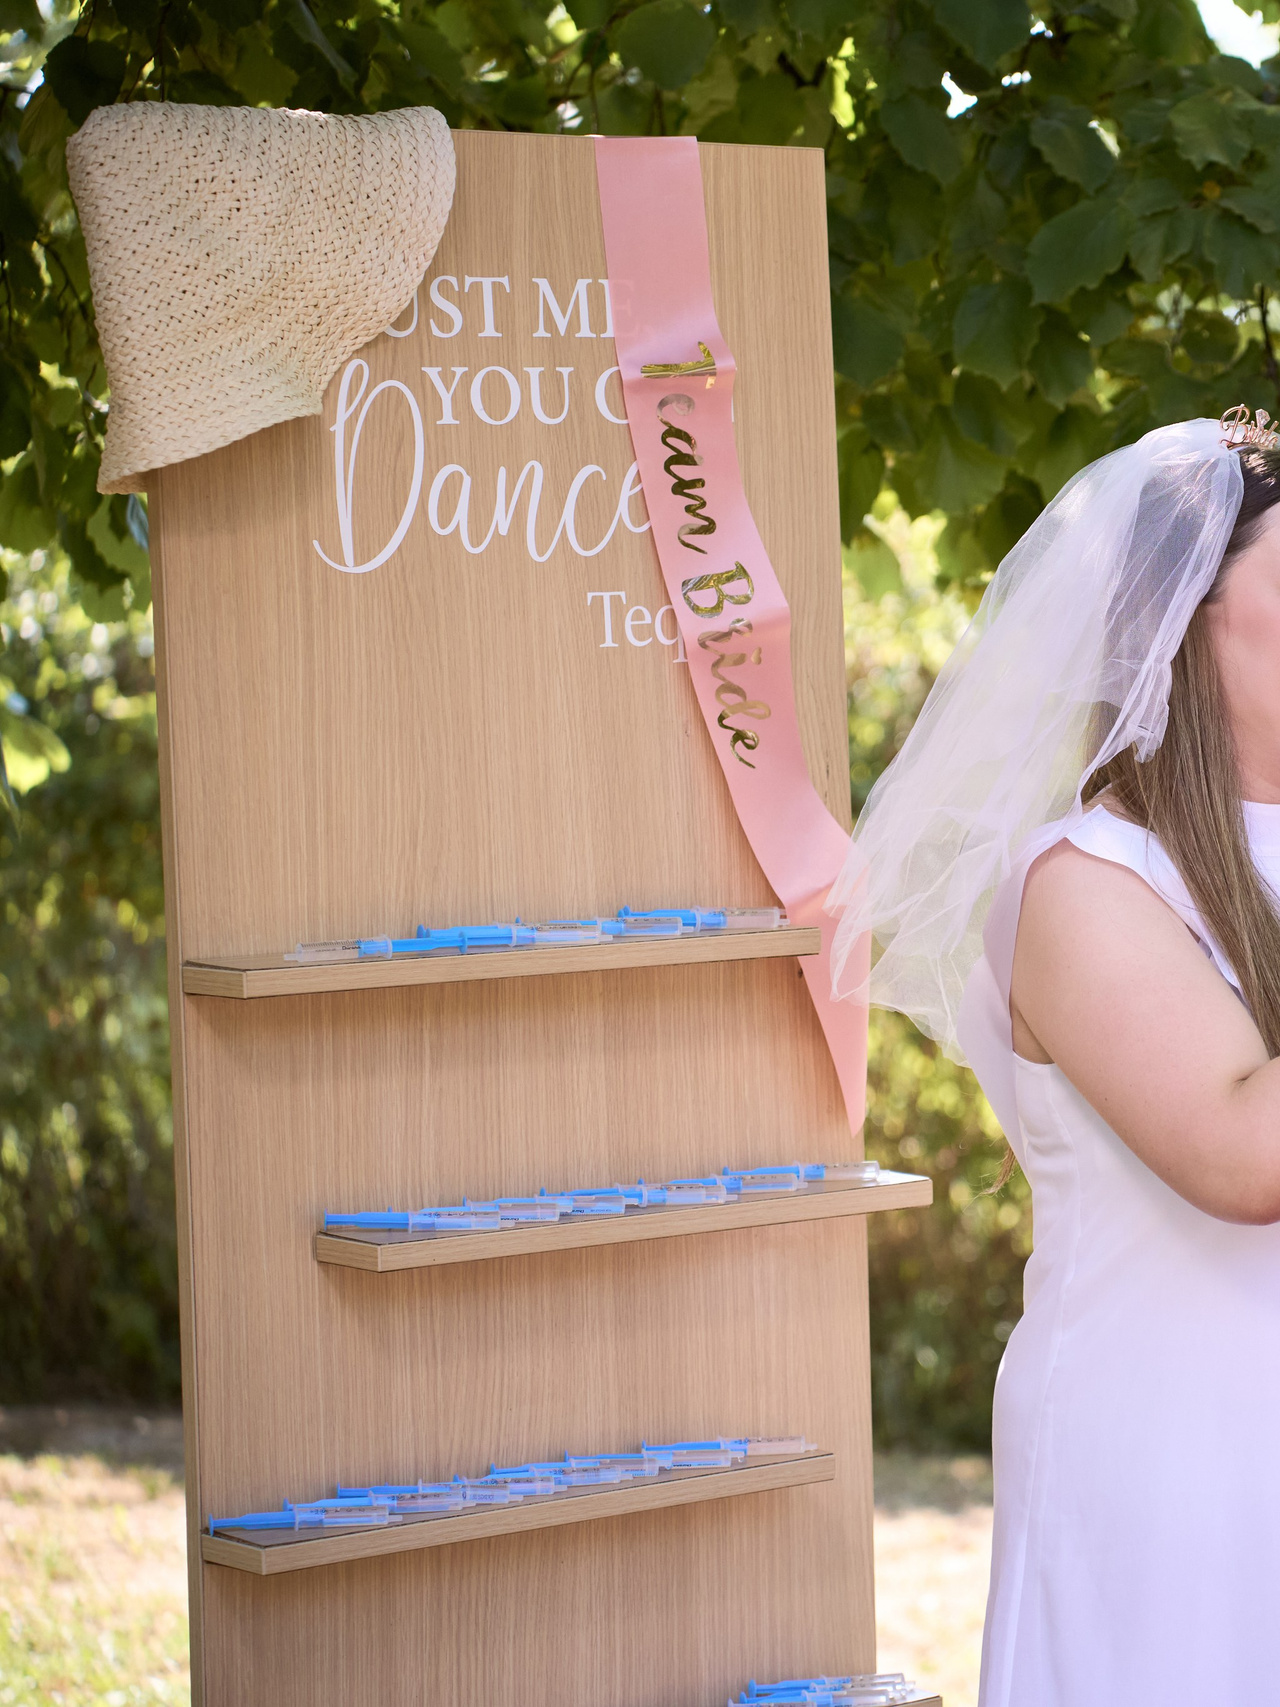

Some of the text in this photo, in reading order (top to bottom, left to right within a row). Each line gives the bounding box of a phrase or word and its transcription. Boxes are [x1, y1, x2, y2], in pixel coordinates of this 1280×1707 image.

[312, 358, 656, 574] Dance
[421, 365, 574, 426] YOU
[640, 341, 771, 769] Team Bride
